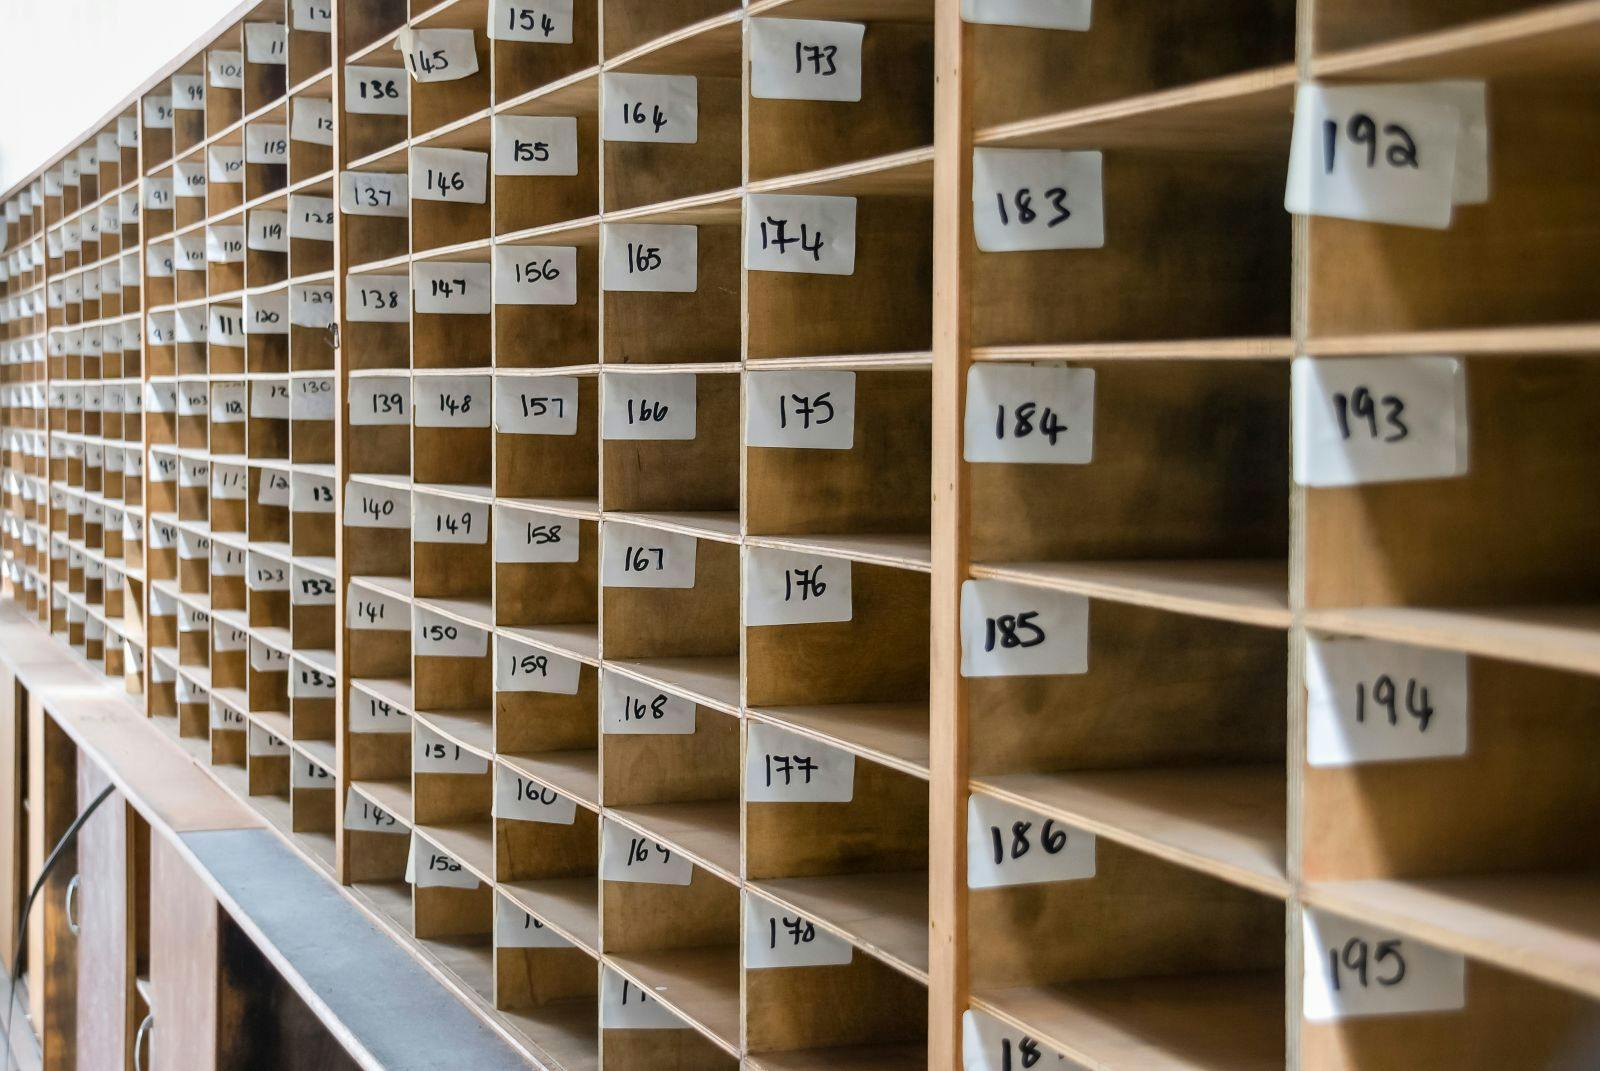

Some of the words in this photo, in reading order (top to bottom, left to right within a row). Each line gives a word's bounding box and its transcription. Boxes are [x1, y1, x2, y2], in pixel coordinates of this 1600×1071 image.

[509, 8, 555, 37] 154
[271, 41, 284, 54] 11
[795, 41, 838, 76] 173
[409, 50, 449, 74] 145
[360, 80, 399, 98] 136
[318, 118, 333, 130] 12
[623, 102, 668, 133] 164
[264, 140, 287, 154] 118
[514, 140, 550, 162] 155
[1322, 113, 1419, 175] 192
[225, 160, 243, 172] 10
[427, 169, 465, 197] 146
[153, 191, 168, 204] 91
[354, 186, 391, 208] 137
[995, 187, 1071, 229] 183
[305, 212, 334, 224] 128
[263, 224, 282, 239] 119
[760, 216, 824, 261] 174
[186, 251, 204, 260] 101
[224, 241, 242, 252] 110
[627, 243, 661, 274] 165
[515, 259, 560, 282] 156
[303, 291, 333, 303] 129
[361, 289, 399, 309] 138
[431, 280, 467, 298] 147
[255, 310, 279, 323] 120
[271, 384, 289, 398] 12
[303, 381, 331, 392] 130
[373, 393, 403, 414] 139
[440, 394, 472, 416] 148
[521, 394, 564, 418] 157
[627, 399, 668, 424] 166
[780, 392, 834, 429] 175
[1332, 385, 1409, 443] 193
[995, 402, 1068, 446] 184
[270, 474, 289, 489] 12
[314, 487, 333, 501] 13
[362, 497, 394, 520] 140
[436, 513, 472, 534] 149
[527, 522, 562, 544] 158
[227, 550, 241, 563] 11
[625, 546, 664, 571] 167
[258, 569, 284, 581] 123
[785, 564, 827, 602] 176
[302, 580, 336, 596] 132
[358, 602, 384, 623] 141
[422, 625, 458, 641] 150
[985, 611, 1046, 653] 185
[266, 648, 291, 660] 12
[511, 655, 549, 677] 159
[369, 700, 408, 717] 14
[624, 694, 668, 721] 168
[1355, 674, 1434, 733] 194
[425, 743, 461, 761] 151
[765, 754, 819, 787] 177
[991, 818, 1067, 866] 186
[1328, 937, 1406, 992] 195
[1001, 1036, 1064, 1071] 18
